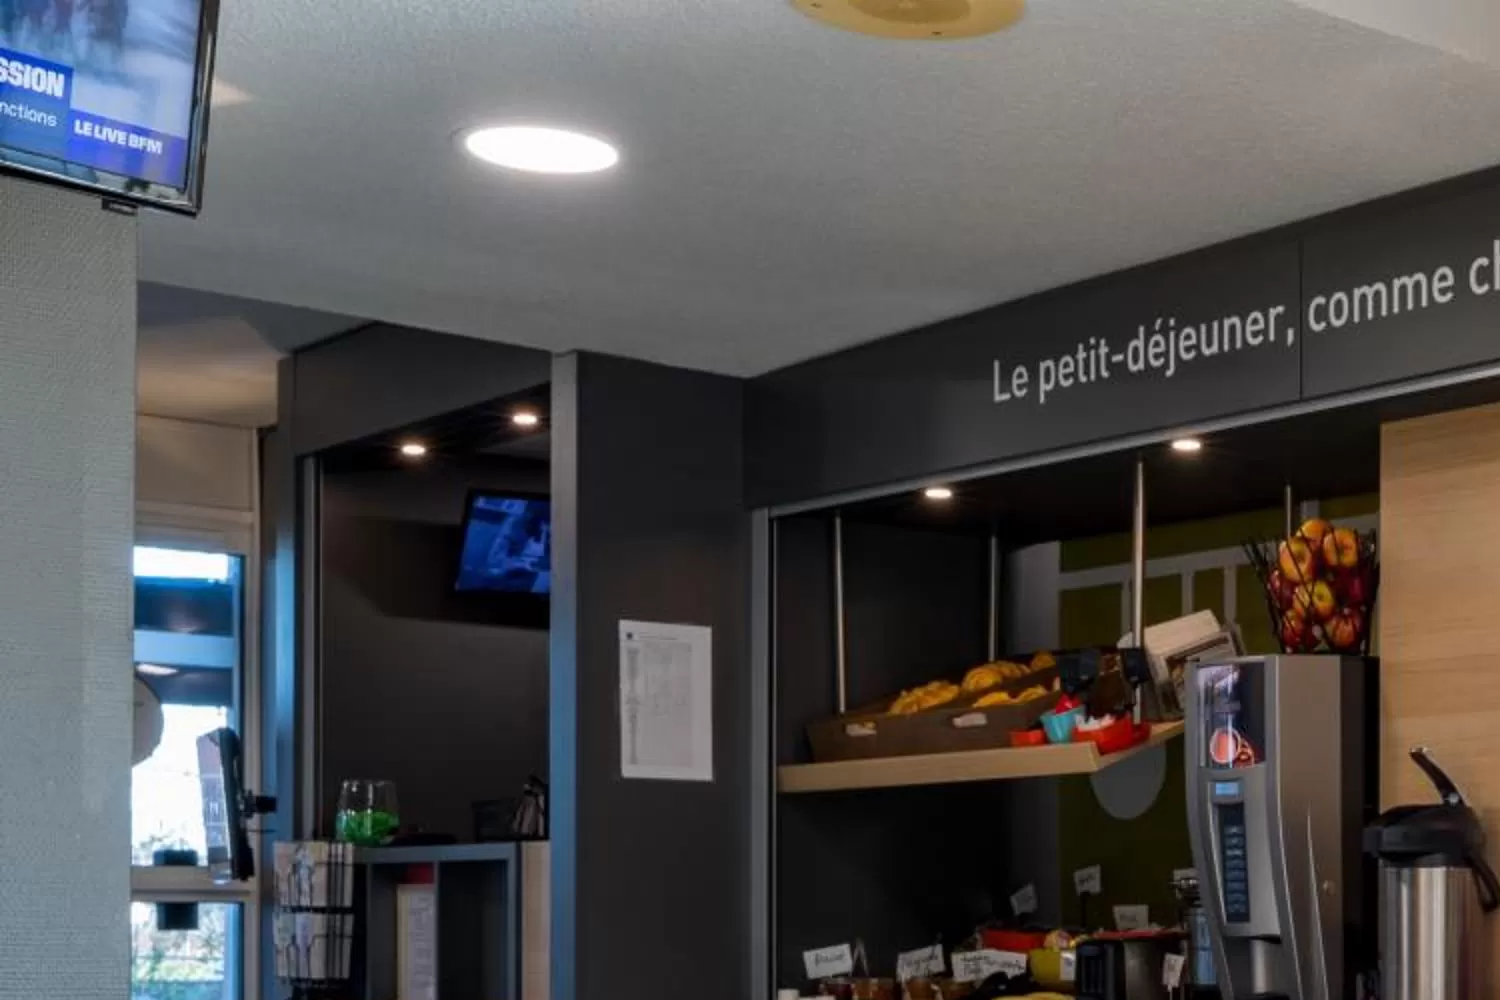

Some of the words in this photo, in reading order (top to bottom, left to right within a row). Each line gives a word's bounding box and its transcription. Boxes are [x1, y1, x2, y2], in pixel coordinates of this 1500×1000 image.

[74, 118, 94, 136] LE
[94, 124, 128, 145] LIVE
[127, 132, 163, 154] BFM
[993, 359, 1029, 404] Le
[1038, 303, 1295, 405] petit-déjeuner,
[1307, 265, 1455, 333] comme
